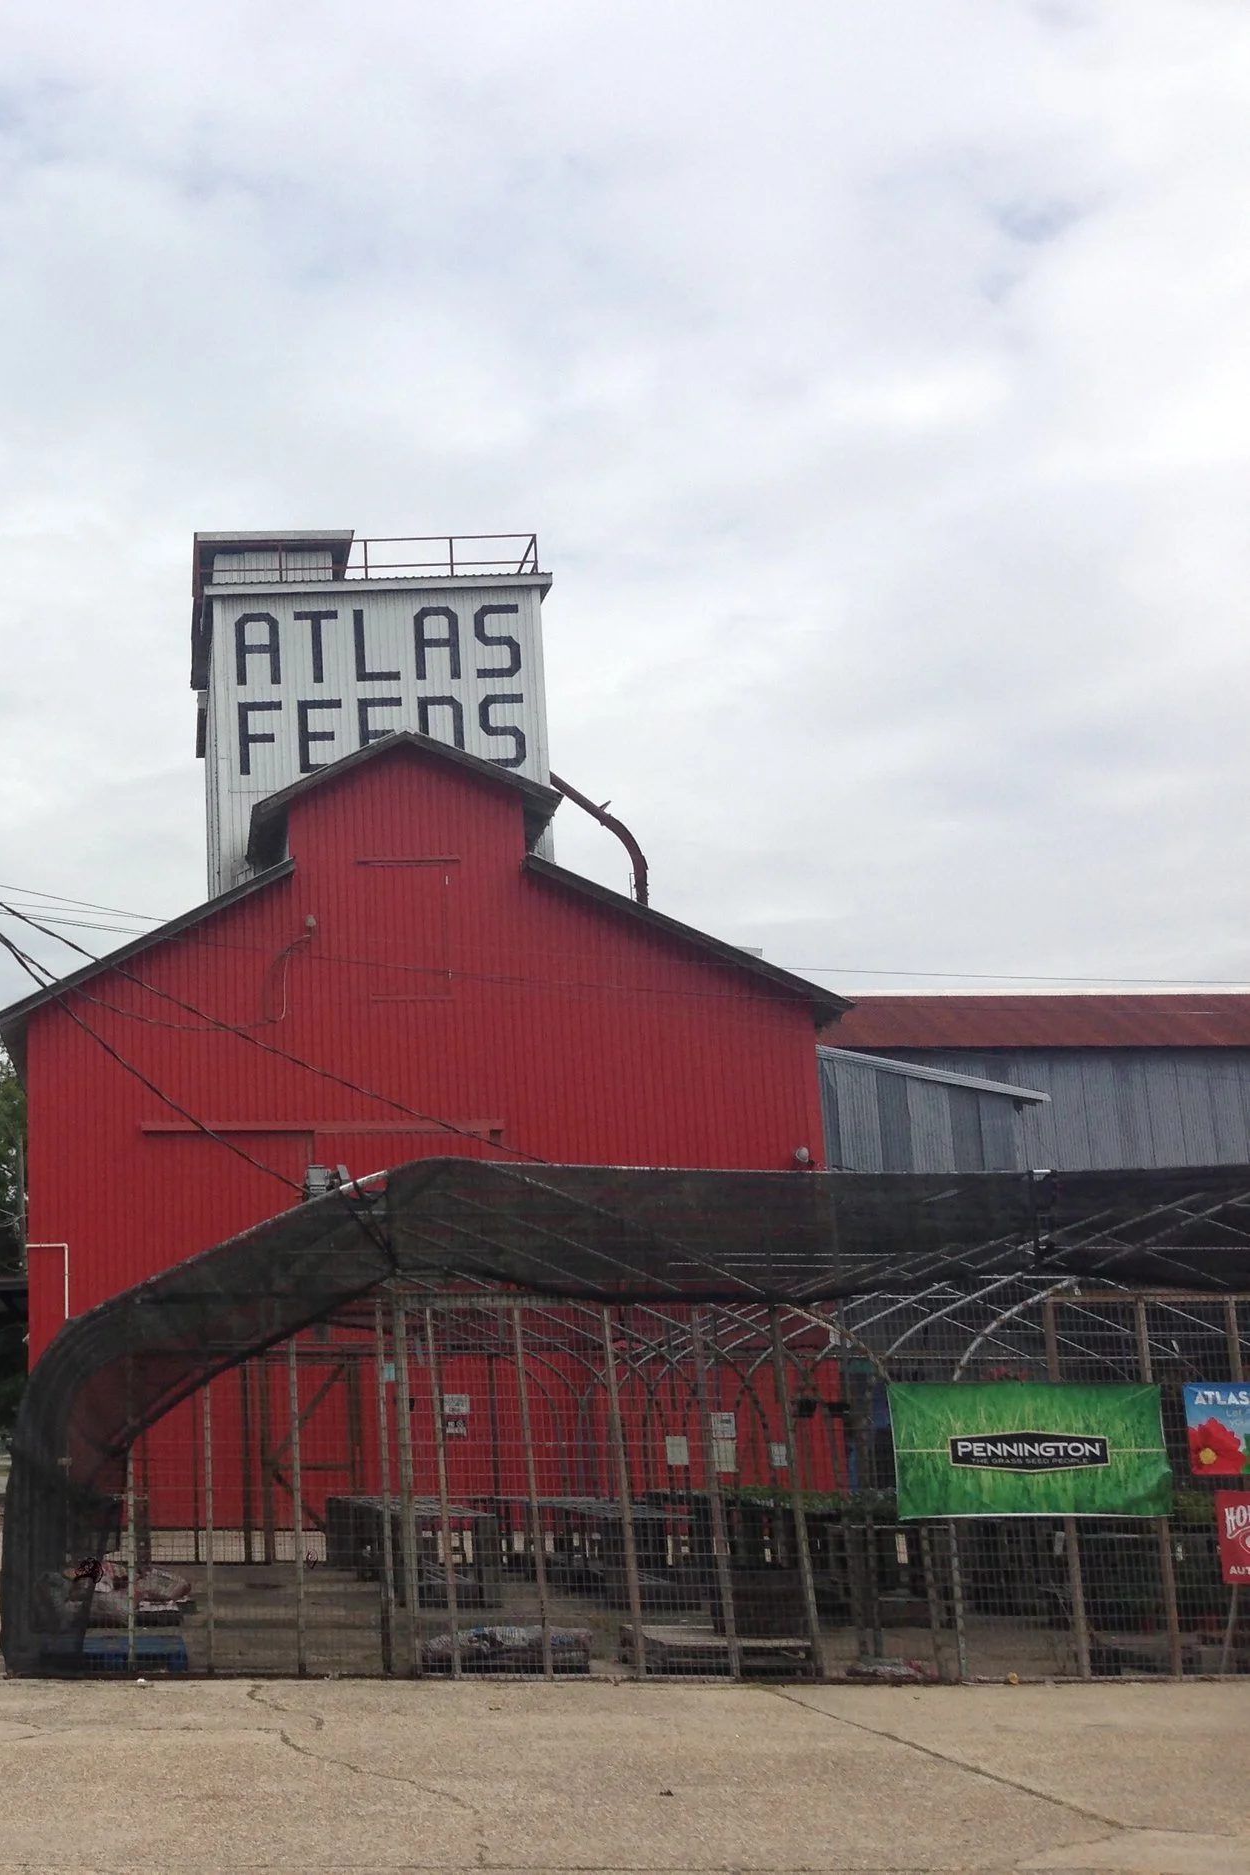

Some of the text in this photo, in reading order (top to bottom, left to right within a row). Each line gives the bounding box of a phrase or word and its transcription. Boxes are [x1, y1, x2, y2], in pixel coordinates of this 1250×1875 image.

[234, 603, 522, 687] ATLAS
[237, 692, 527, 776] FEEDS
[1194, 1390, 1250, 1406] ATLAS
[957, 1441, 1101, 1457] PENNINGTON
[1224, 1504, 1250, 1537] HO
